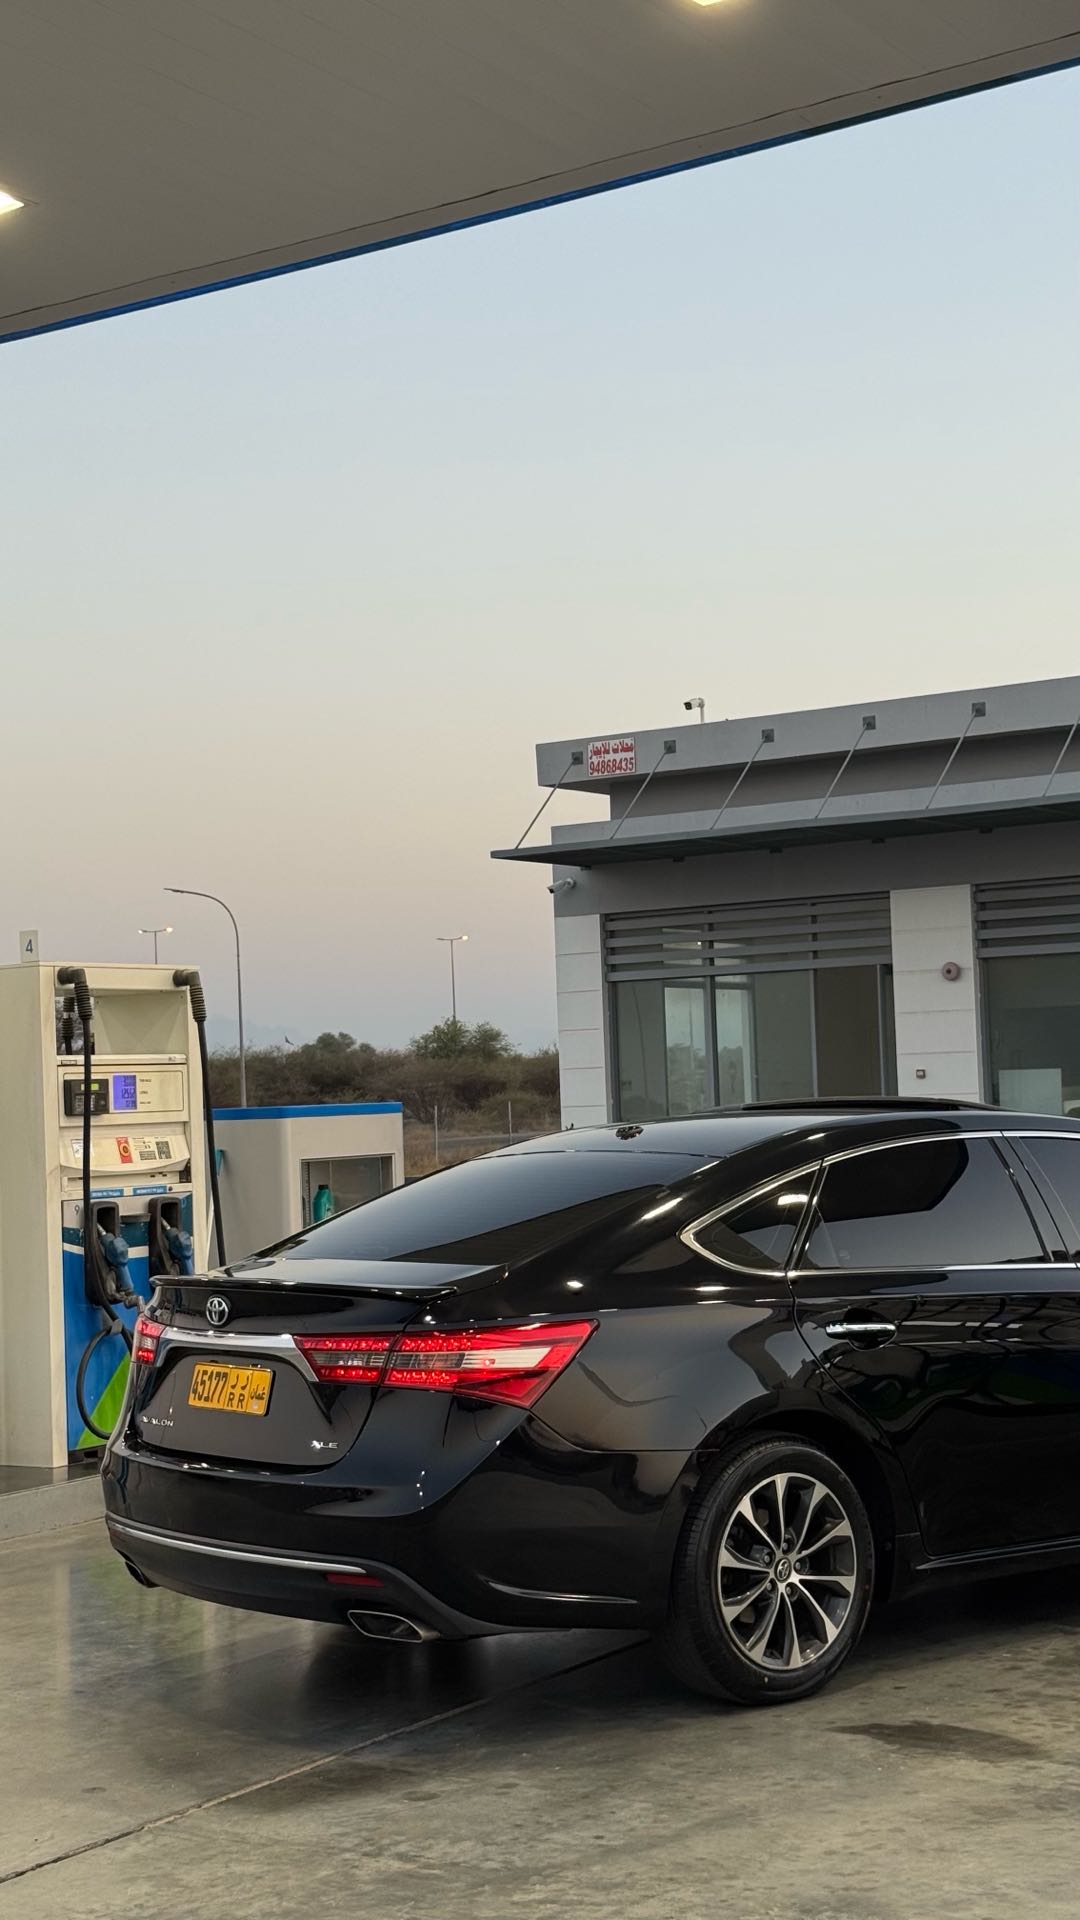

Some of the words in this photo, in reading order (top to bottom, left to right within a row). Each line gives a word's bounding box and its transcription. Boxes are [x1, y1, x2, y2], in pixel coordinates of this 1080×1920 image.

[590, 741, 610, 759] للإيجار
[612, 739, 634, 753] محلات
[589, 757, 634, 775] 94868435
[25, 938, 34, 954] 4
[74, 1204, 80, 1216] 9
[191, 1369, 229, 1404] 45177
